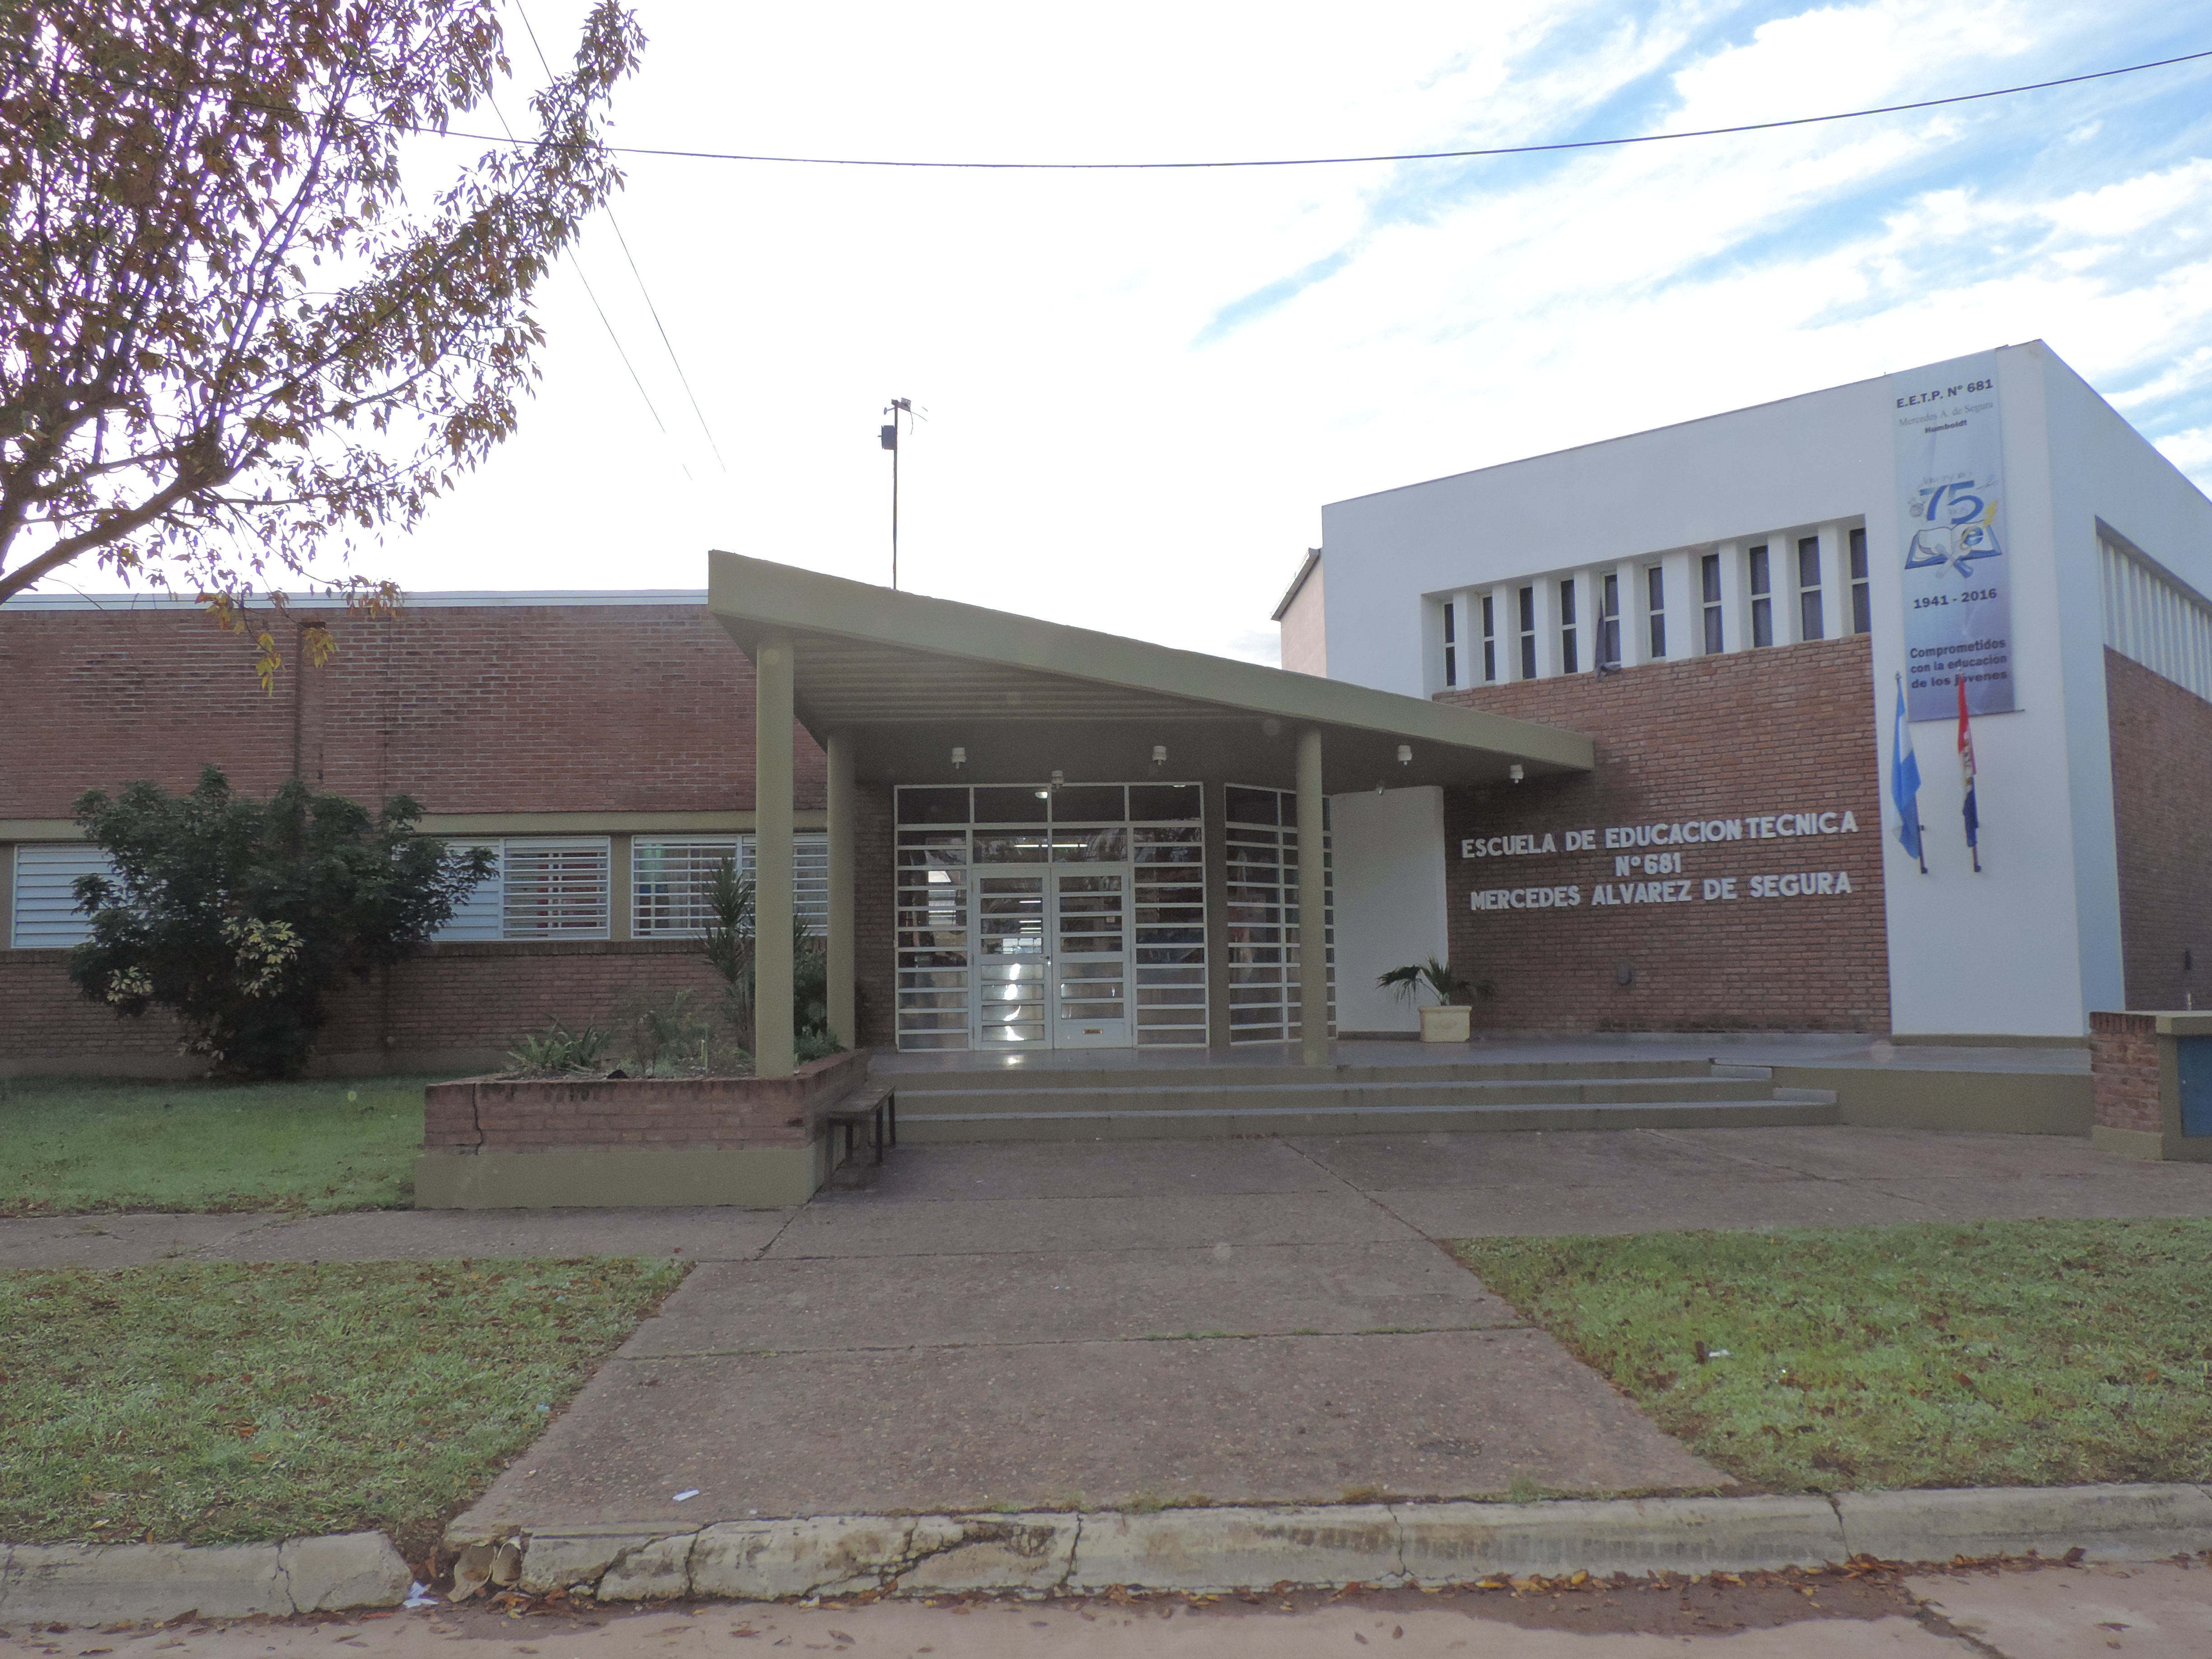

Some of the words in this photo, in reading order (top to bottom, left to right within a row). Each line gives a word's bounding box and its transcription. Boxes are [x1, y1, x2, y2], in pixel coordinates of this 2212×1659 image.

[1897, 390, 1943, 408] E.E.T.P.
[1967, 379, 1993, 393] 681
[1952, 407, 1962, 416] de
[1965, 402, 1993, 414] Segura
[1925, 419, 1967, 433] Humboldt
[1919, 480, 1984, 525] 75
[1914, 595, 1948, 609] 1941
[1961, 588, 1996, 603] 2016
[1910, 639, 2006, 659] Comprometidos
[1911, 663, 1931, 674] con
[1934, 661, 1944, 670] la
[1911, 679, 1927, 689] de
[1931, 676, 1951, 687] los
[1462, 833, 1556, 858] ESCUELA
[1565, 830, 1596, 851] DE
[1605, 819, 1743, 848] EDUCACION
[1746, 811, 1859, 839] TECNICA
[1471, 885, 1581, 910] MERCEDES
[1591, 880, 1692, 905] ALVAREZ
[1703, 877, 1738, 900] DE
[1750, 871, 1852, 898] SEGURA
